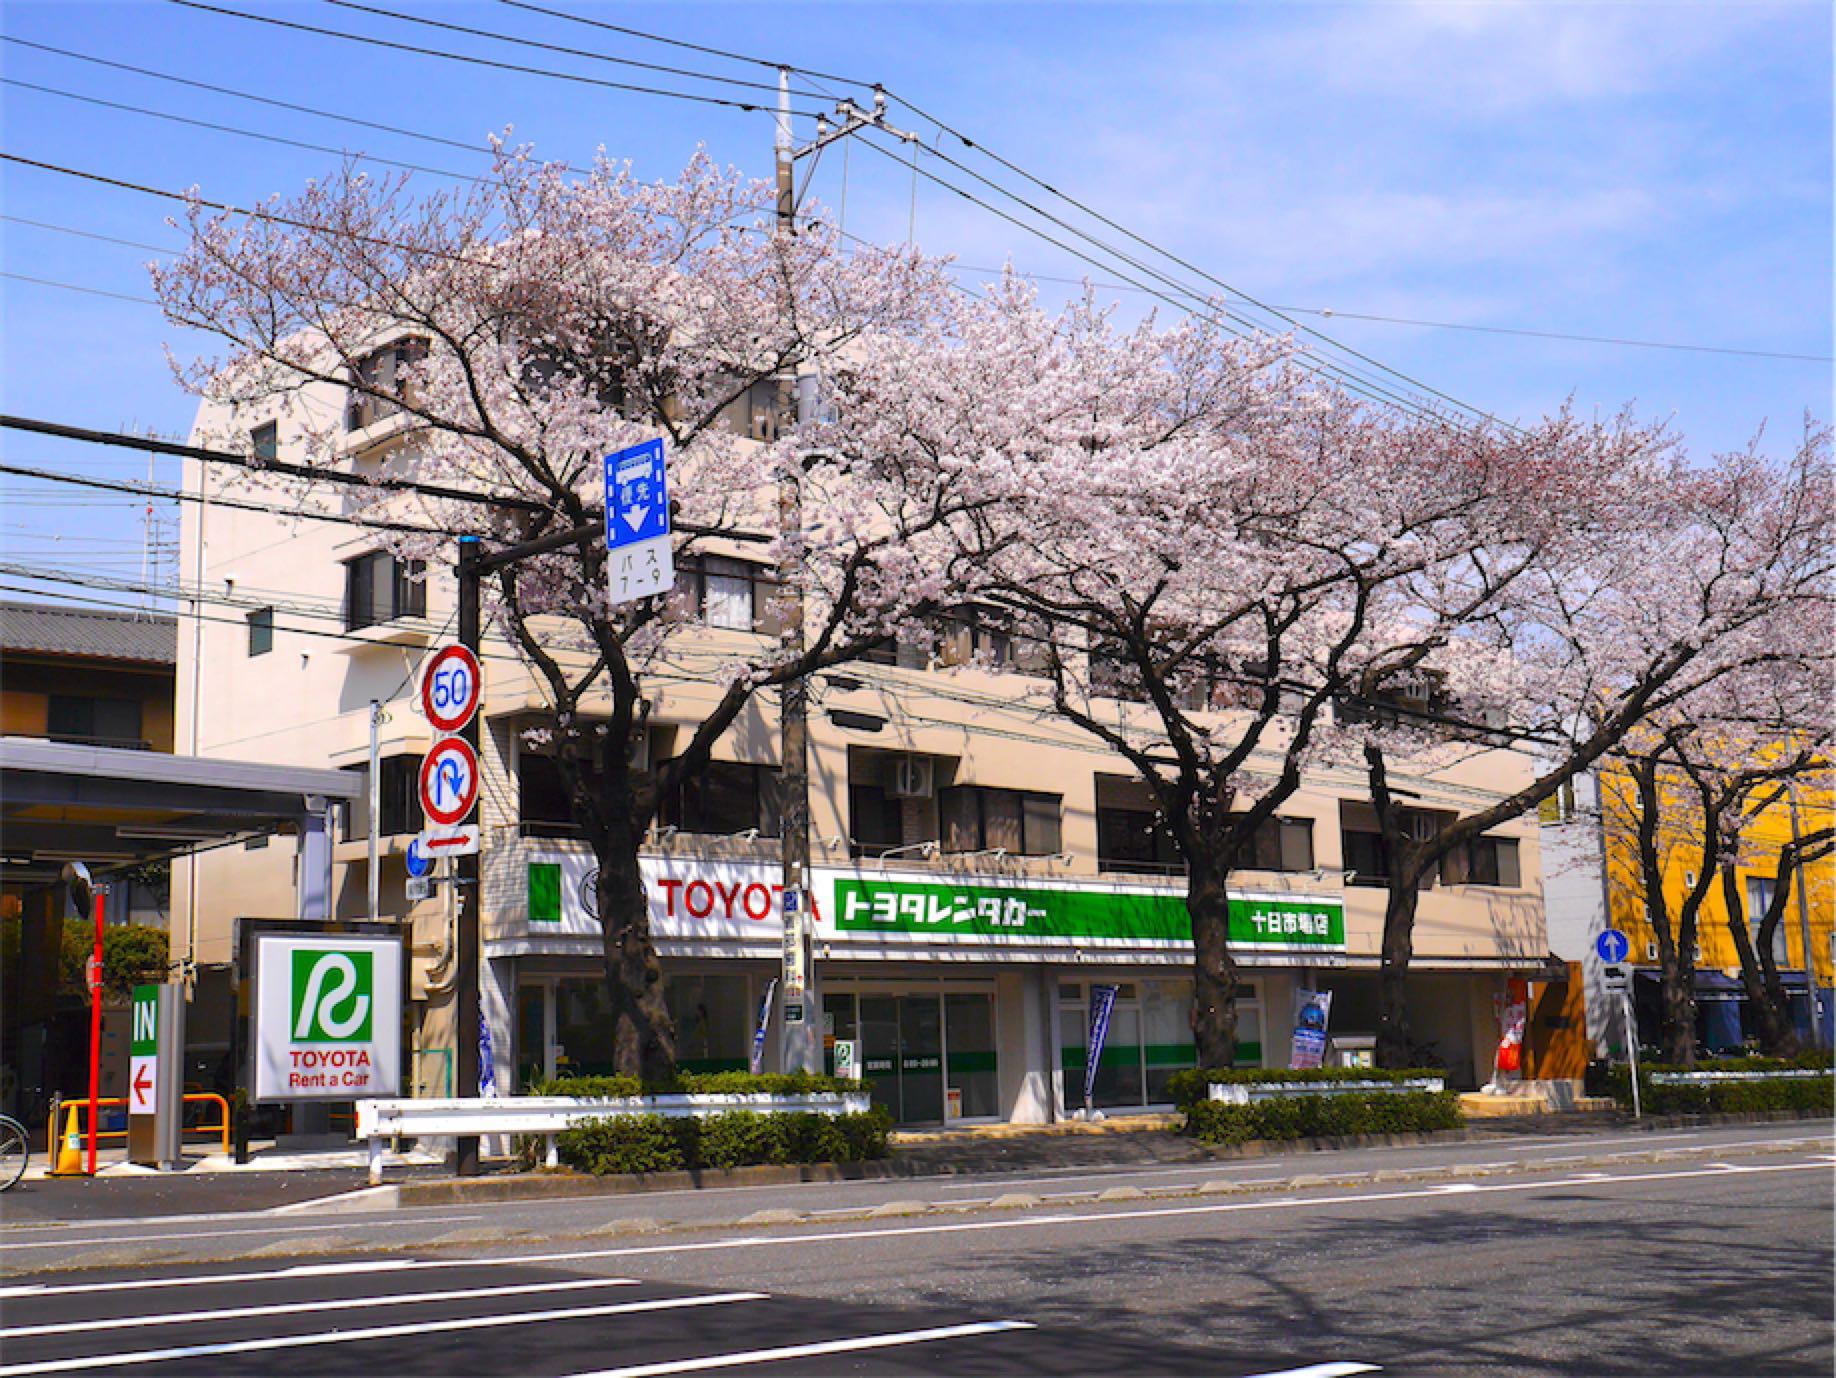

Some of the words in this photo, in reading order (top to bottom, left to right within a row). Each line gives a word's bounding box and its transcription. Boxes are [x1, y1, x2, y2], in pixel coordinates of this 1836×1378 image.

[435, 670, 466, 708] 50
[844, 891, 1047, 927] トヨタレンタカー
[133, 1001, 156, 1041] IN
[289, 1050, 371, 1067] TOYOTA
[289, 1072, 325, 1087] Rent
[330, 1076, 339, 1087] a
[342, 1071, 369, 1086] Car
